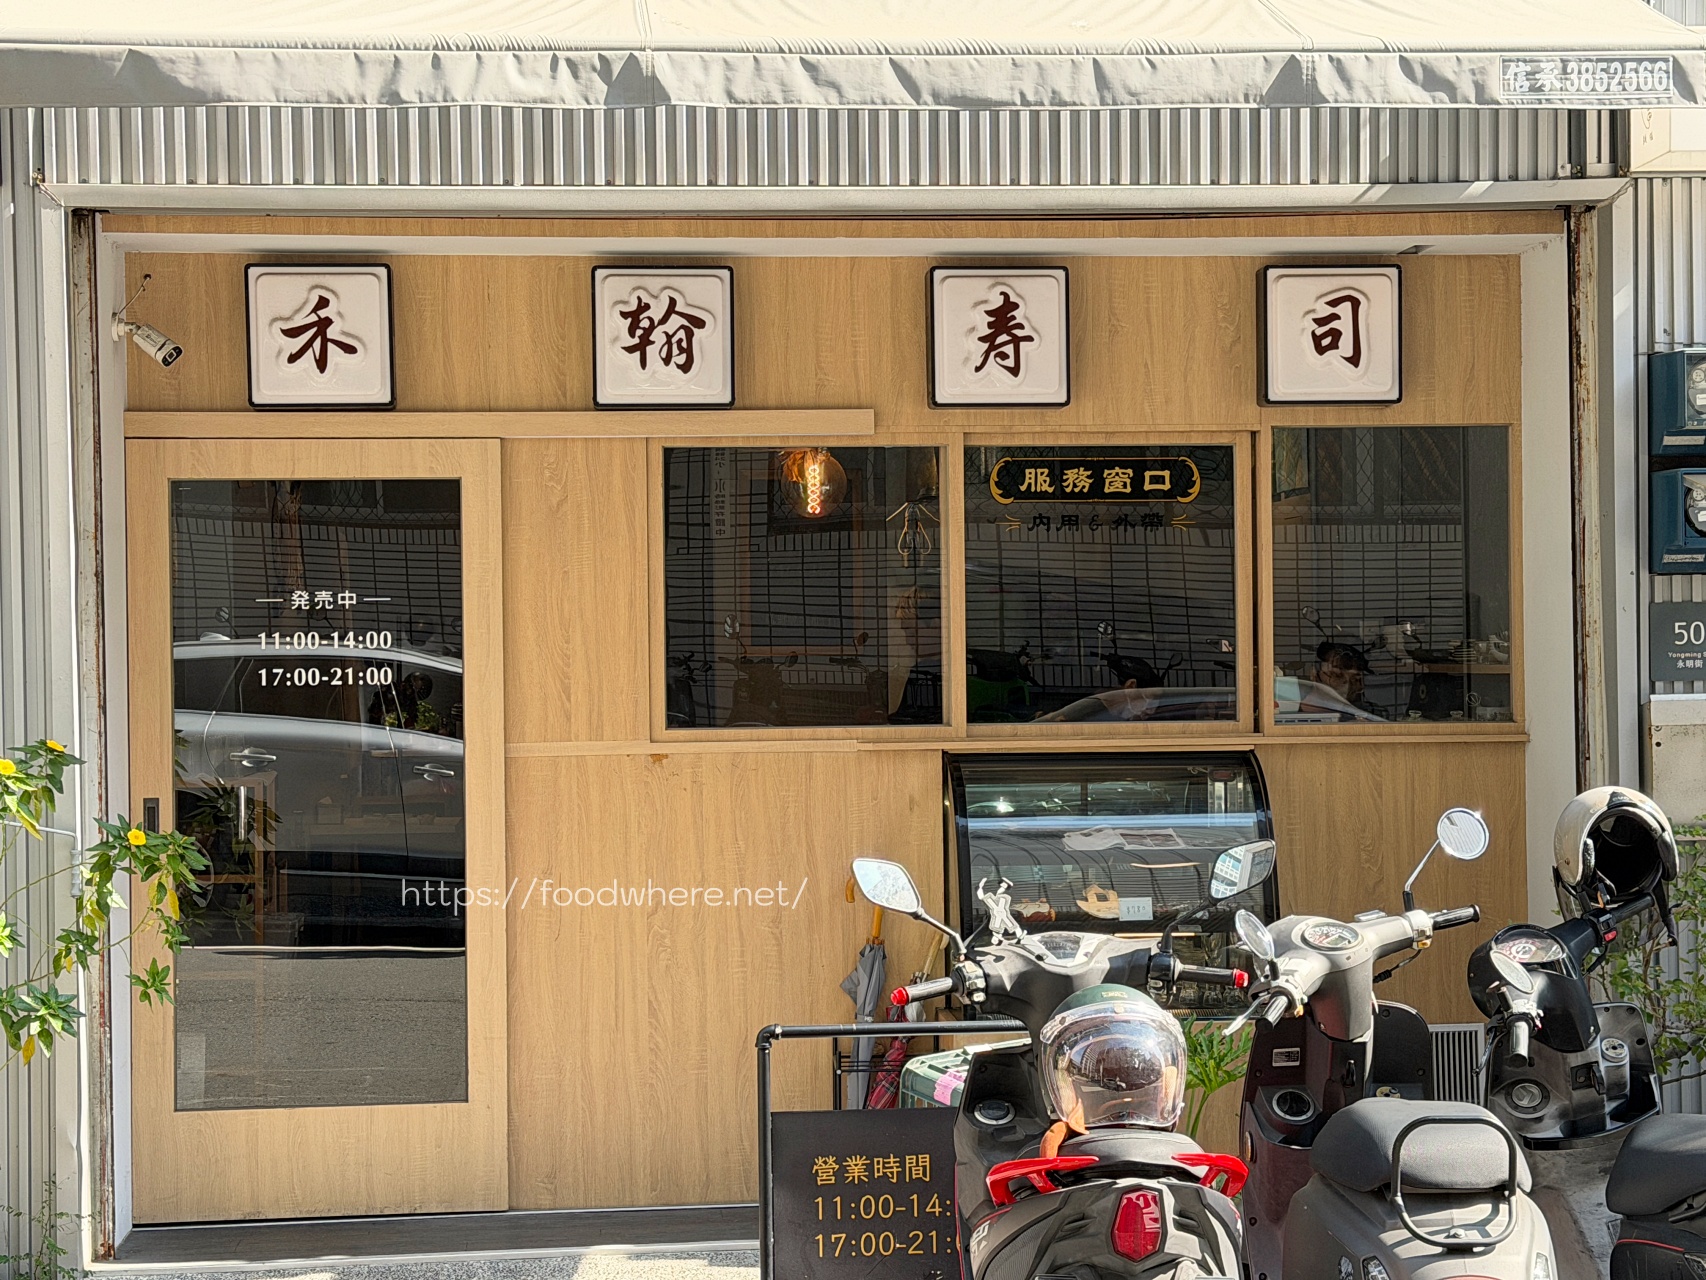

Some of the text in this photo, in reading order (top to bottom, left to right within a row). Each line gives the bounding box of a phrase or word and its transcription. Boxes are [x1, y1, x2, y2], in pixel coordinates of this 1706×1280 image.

[279, 291, 1361, 378] 禾 翰 寿 司
[1018, 466, 1172, 493] 服務窗口
[290, 589, 358, 610] 発売中
[256, 630, 393, 651] 11:00-14:00
[1674, 620, 1706, 646] 50
[1667, 651, 1702, 660] Yongming
[1676, 659, 1704, 669] 永明街
[257, 666, 394, 687] 17:00-21:00
[812, 1153, 931, 1186] 營業時間
[814, 1193, 952, 1221] 11:00-14:
[814, 1230, 952, 1258] 17:00-21:
